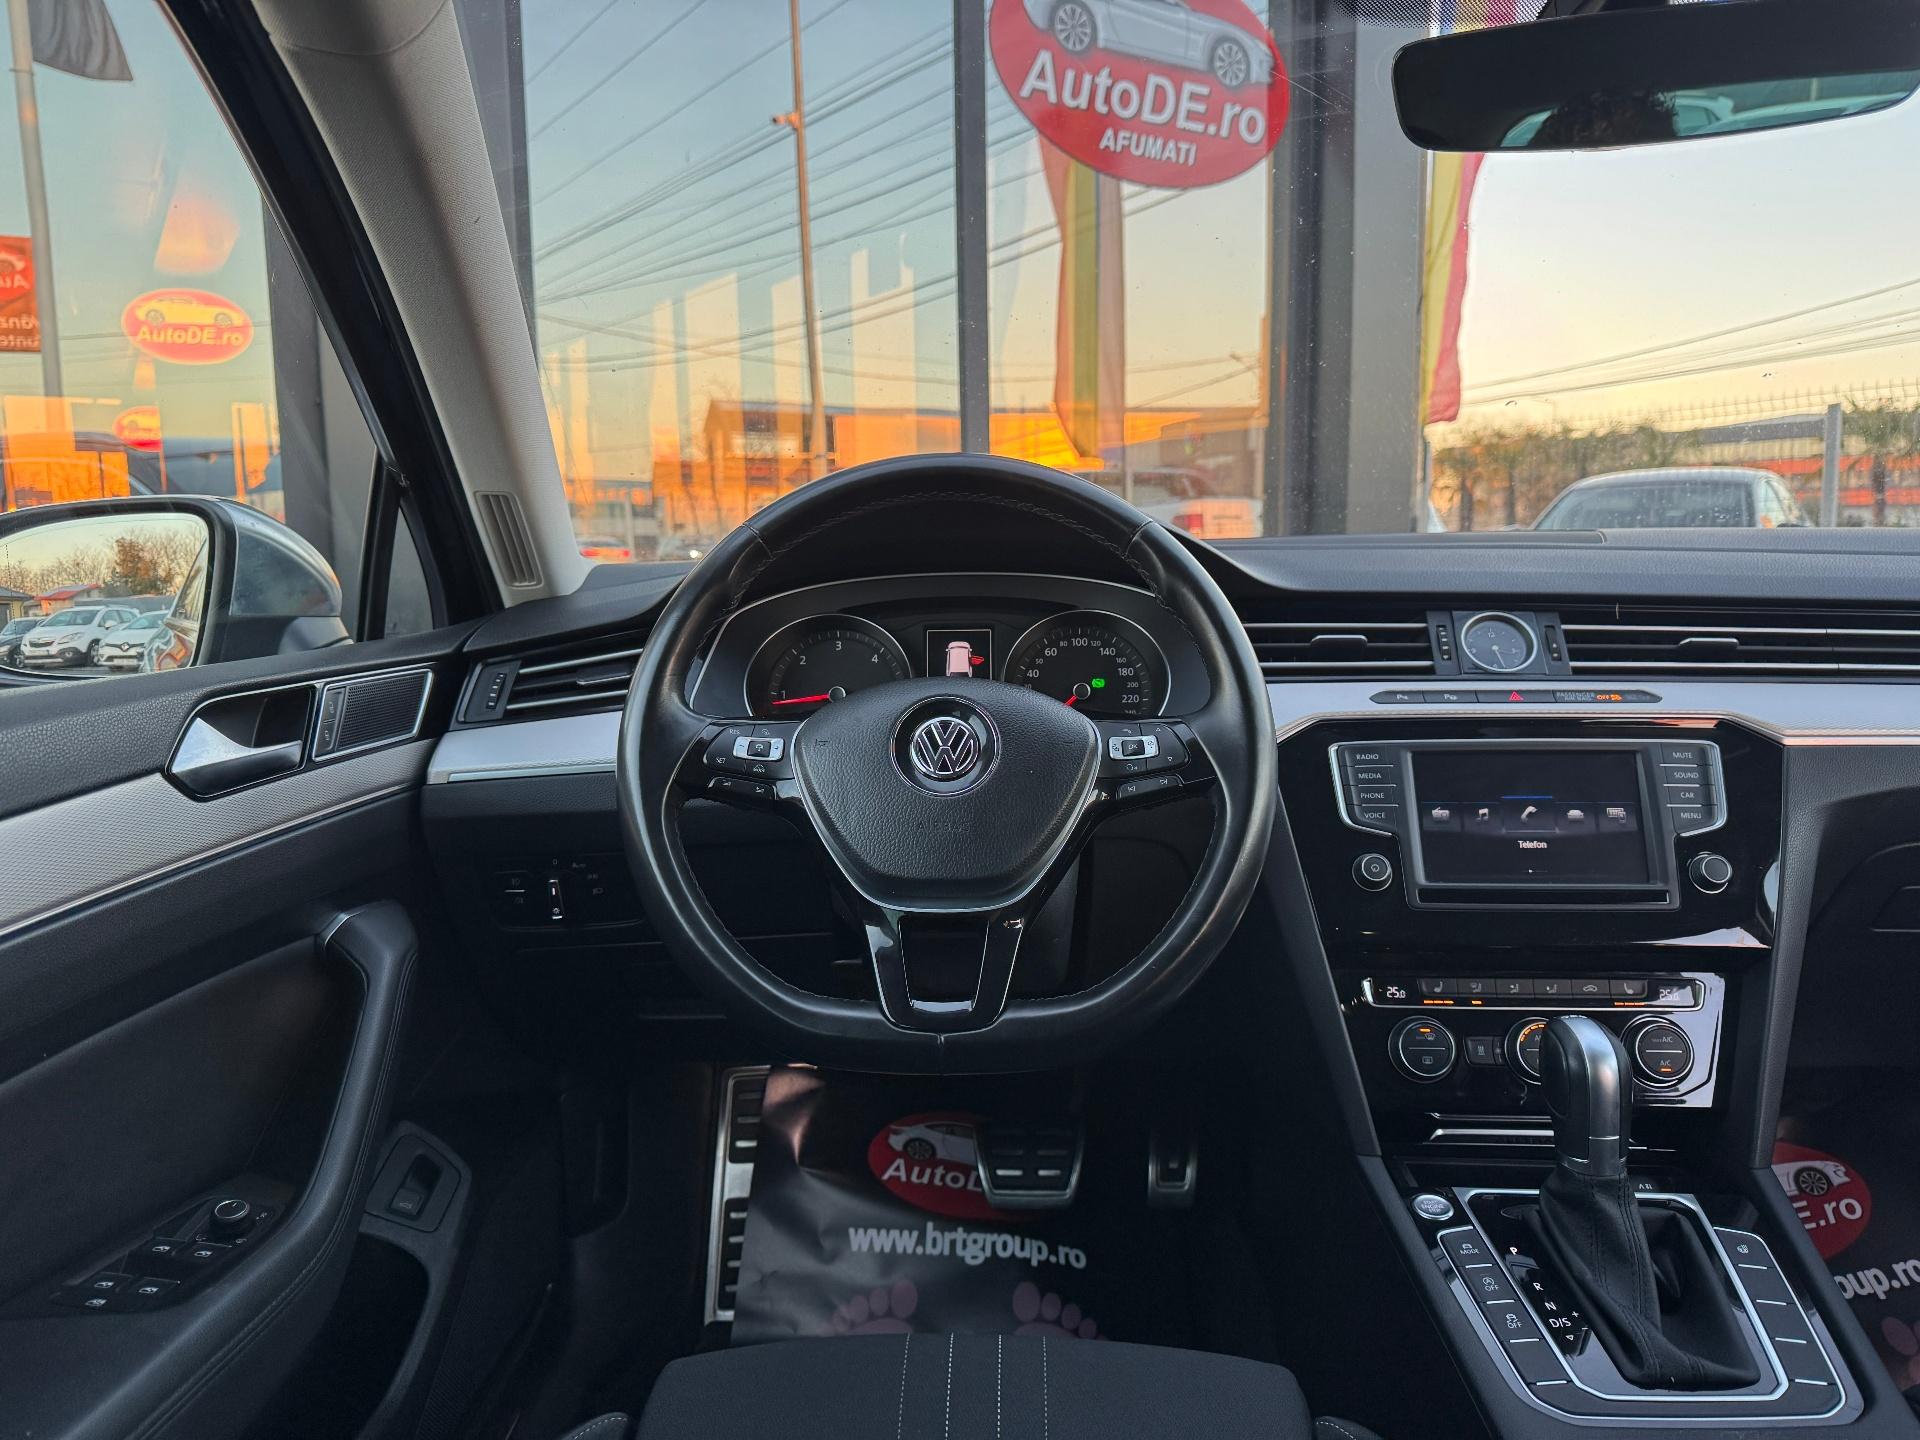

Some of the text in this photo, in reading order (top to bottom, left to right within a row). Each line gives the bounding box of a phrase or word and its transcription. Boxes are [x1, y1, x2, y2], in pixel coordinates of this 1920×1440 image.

[1020, 49, 1266, 144] AutoDE.ro
[1100, 127, 1197, 166] AFUMATI
[136, 325, 244, 345] AutoDE.ro
[835, 641, 842, 650] 3
[1071, 638, 1088, 646] 100
[1045, 648, 1057, 656] 60
[1100, 648, 1116, 656] 140
[800, 656, 806, 665] 2
[871, 654, 879, 663] 4
[1027, 669, 1039, 678] 40
[1118, 668, 1134, 676] 180
[1121, 694, 1139, 703] 220
[1517, 840, 1548, 849] Telefon
[849, 1221, 1087, 1269] www.brtgroup.ro
[1509, 1247, 1518, 1256] P
[1484, 1284, 1499, 1292] OFF
[1532, 1282, 1544, 1291] R
[1544, 1301, 1557, 1310] N
[1507, 1321, 1522, 1329] OFF
